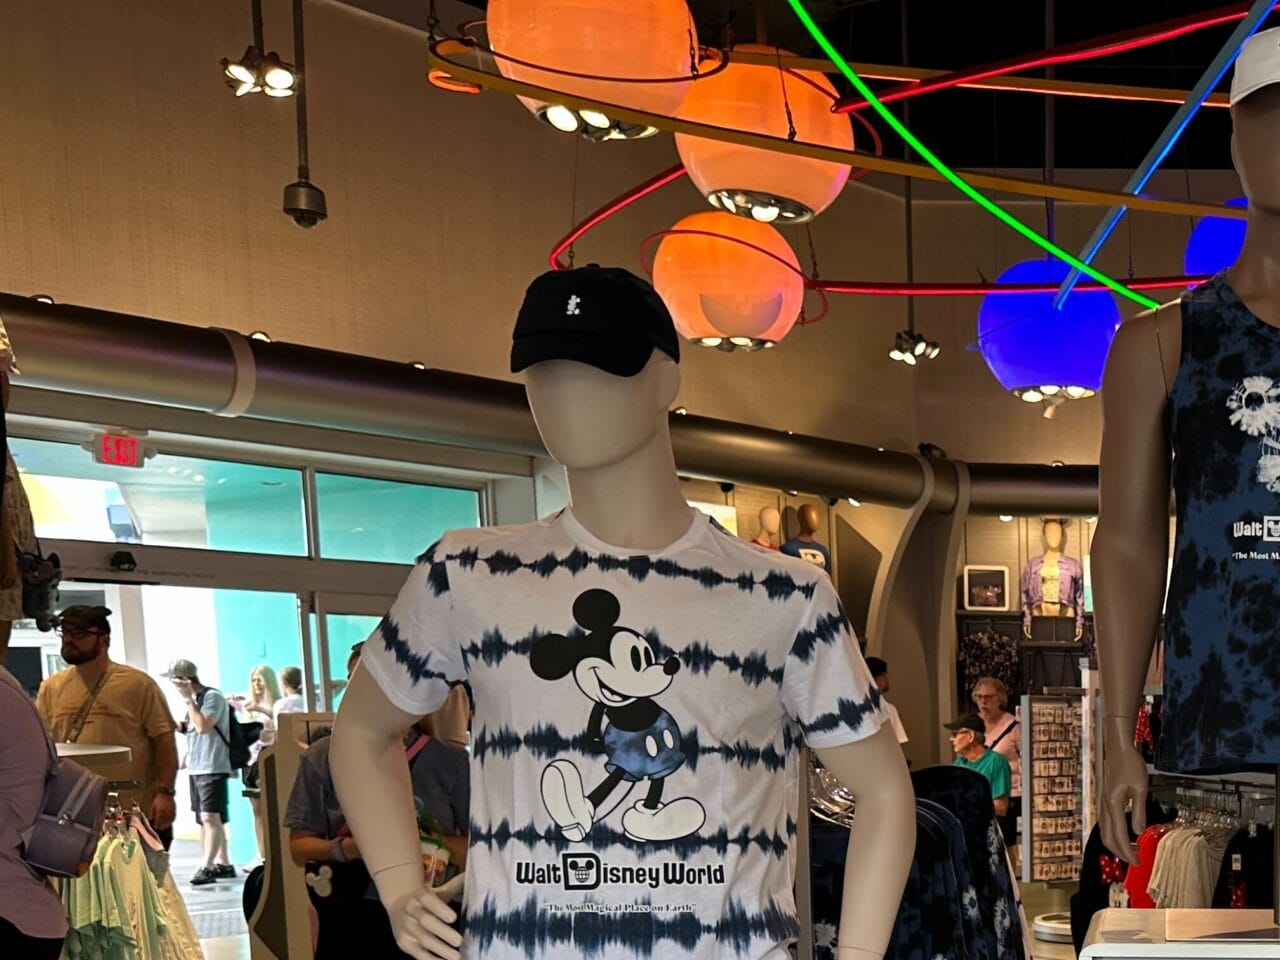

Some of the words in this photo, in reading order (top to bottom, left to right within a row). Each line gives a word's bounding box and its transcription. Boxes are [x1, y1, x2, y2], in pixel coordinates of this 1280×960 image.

[102, 434, 138, 465] EXIT
[1233, 521, 1263, 538] Walt
[1249, 551, 1269, 560] Most
[516, 862, 561, 884] Walt
[561, 853, 660, 890] Disney
[663, 862, 726, 884] World
[586, 903, 622, 914] Magical
[624, 903, 649, 912] Place
[651, 904, 664, 912] on
